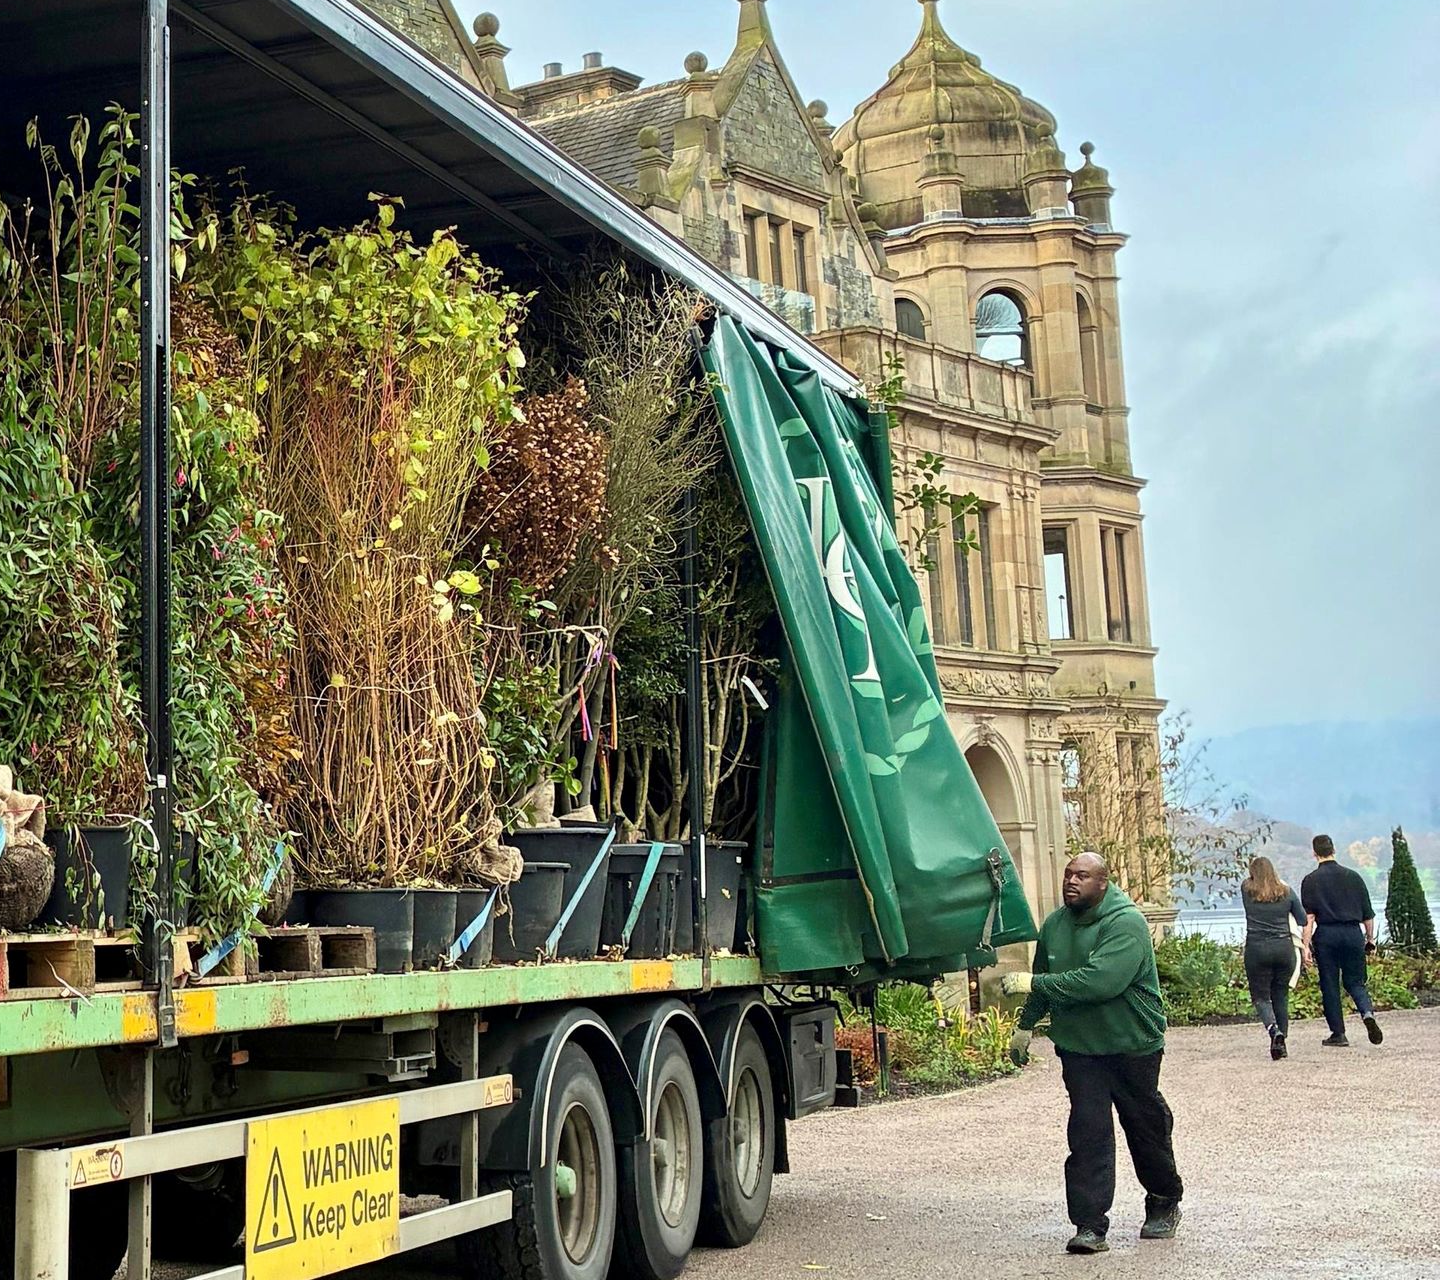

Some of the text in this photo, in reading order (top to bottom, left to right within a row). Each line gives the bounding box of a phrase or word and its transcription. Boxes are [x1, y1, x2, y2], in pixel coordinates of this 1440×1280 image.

[302, 1132, 393, 1189] WARNING
[303, 1189, 393, 1240] Keep Clear
